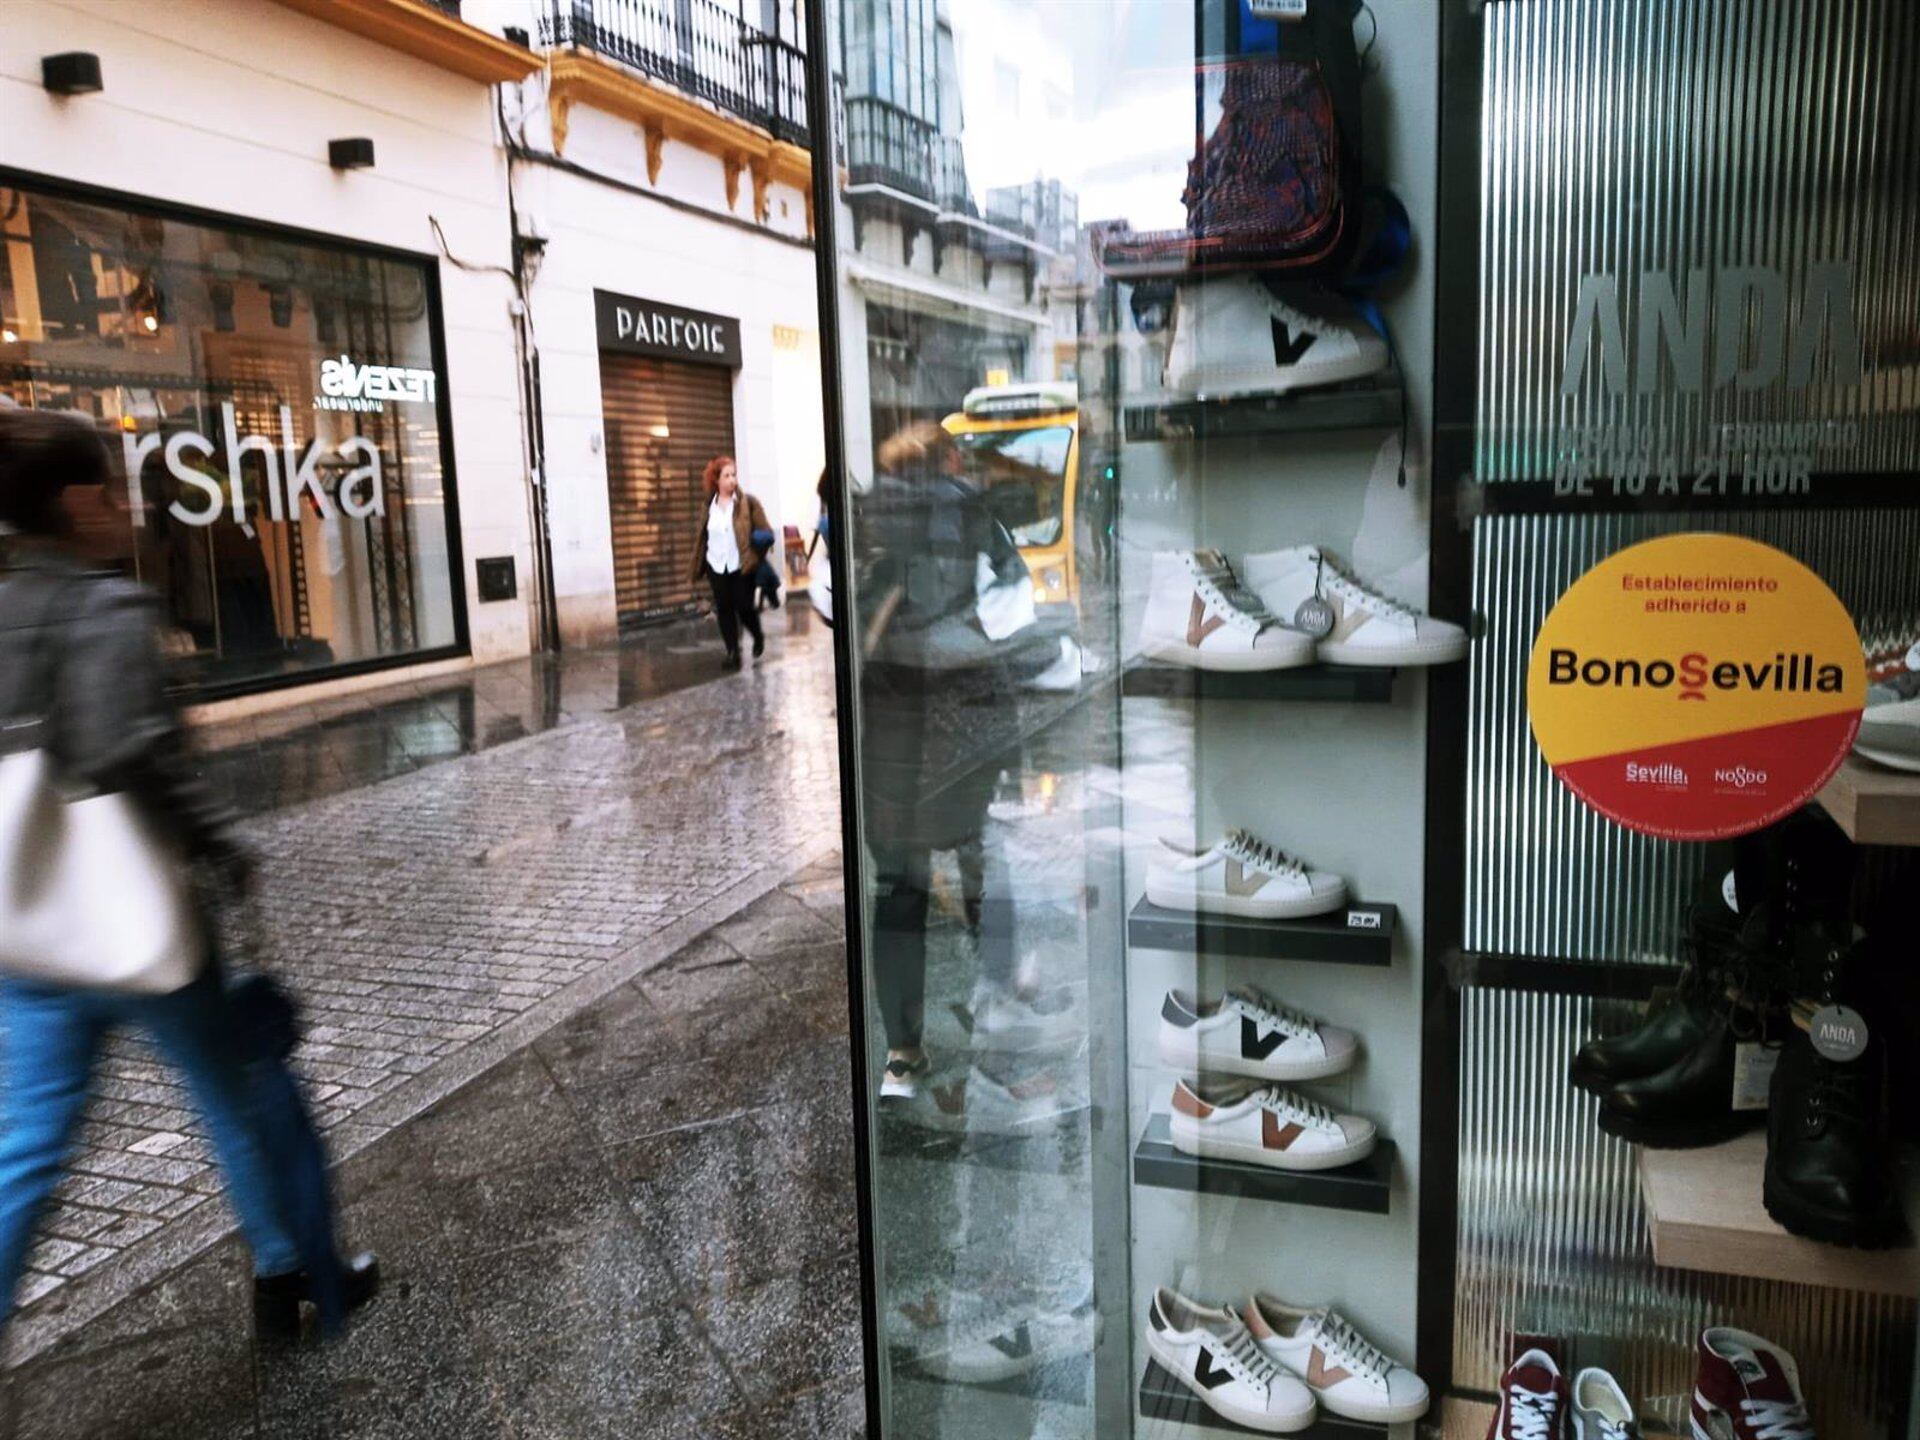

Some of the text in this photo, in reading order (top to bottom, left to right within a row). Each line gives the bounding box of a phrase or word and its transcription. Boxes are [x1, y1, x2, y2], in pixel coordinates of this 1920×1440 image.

[1559, 261, 1860, 394] ANDA
[122, 401, 385, 527] rshka
[1554, 455, 1594, 496] DE
[1611, 455, 1649, 495] 10
[1656, 455, 1680, 496] A
[1691, 455, 1729, 496] 21
[1622, 574, 1778, 593] Establecimiento
[1644, 597, 1746, 614] adherido a
[1549, 648, 1844, 694] BonoSevilla
[1819, 1023, 1856, 1045] ANDA
